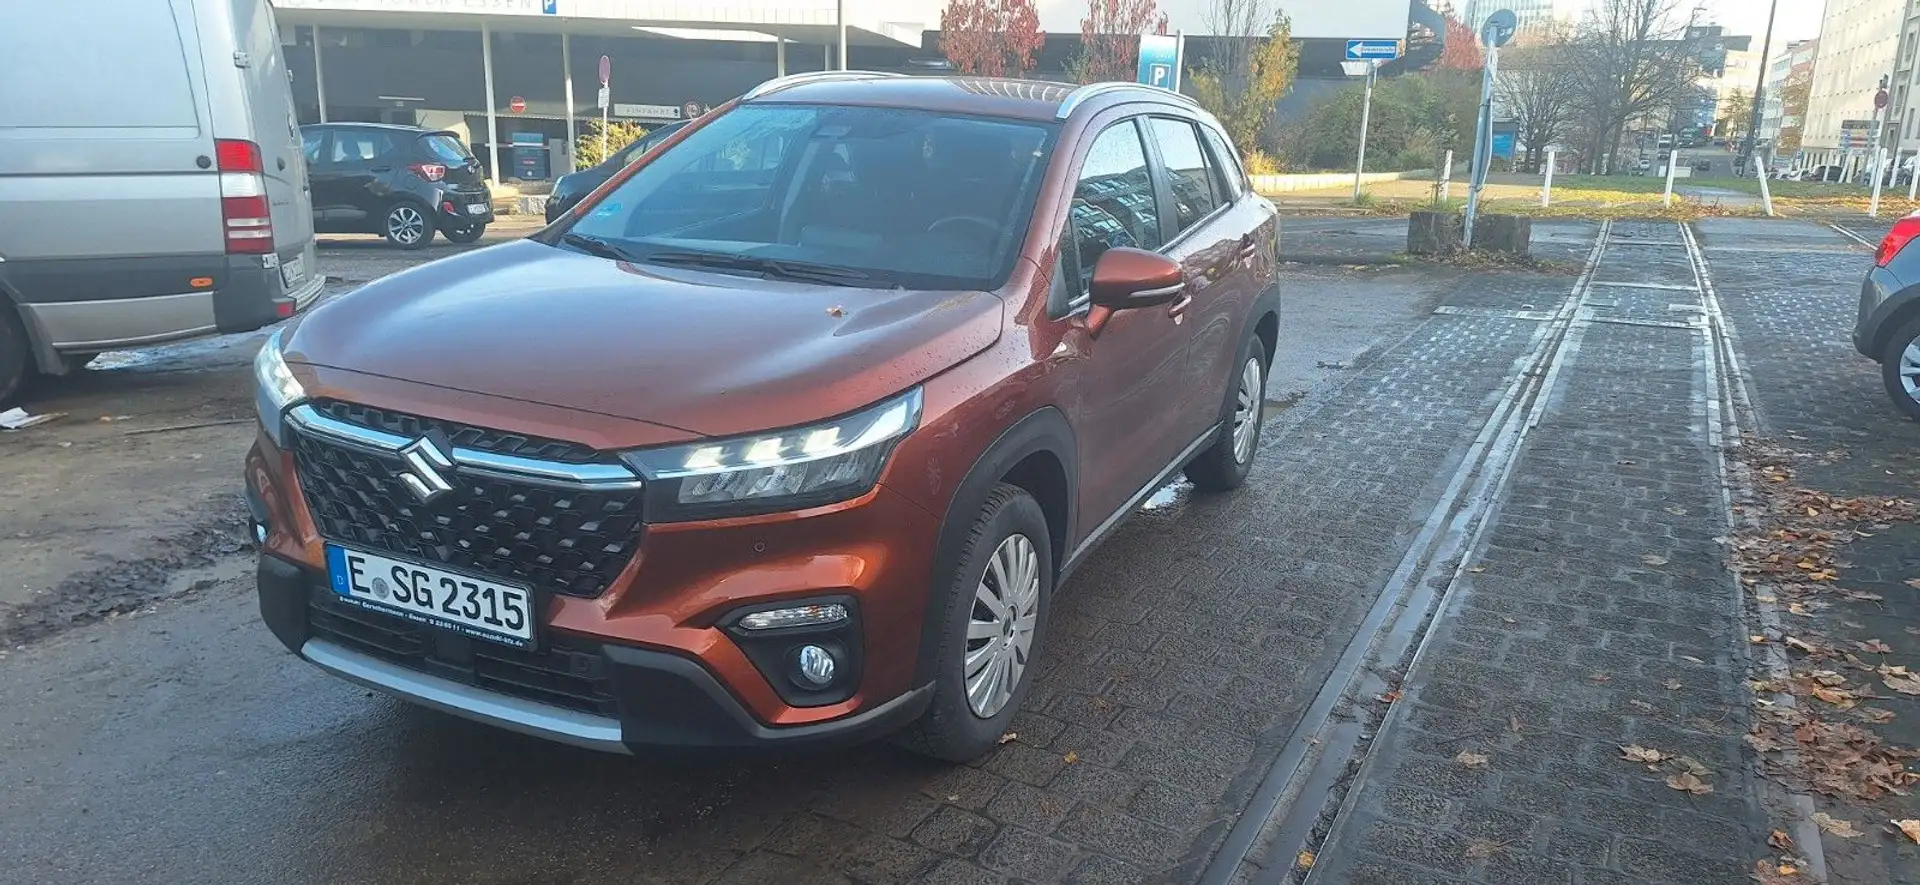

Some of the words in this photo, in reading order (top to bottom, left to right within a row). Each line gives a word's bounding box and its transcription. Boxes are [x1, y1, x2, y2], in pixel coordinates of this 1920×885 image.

[1154, 67, 1166, 86] P
[348, 555, 371, 594] E
[391, 565, 434, 610] SG
[440, 577, 525, 631] 2315
